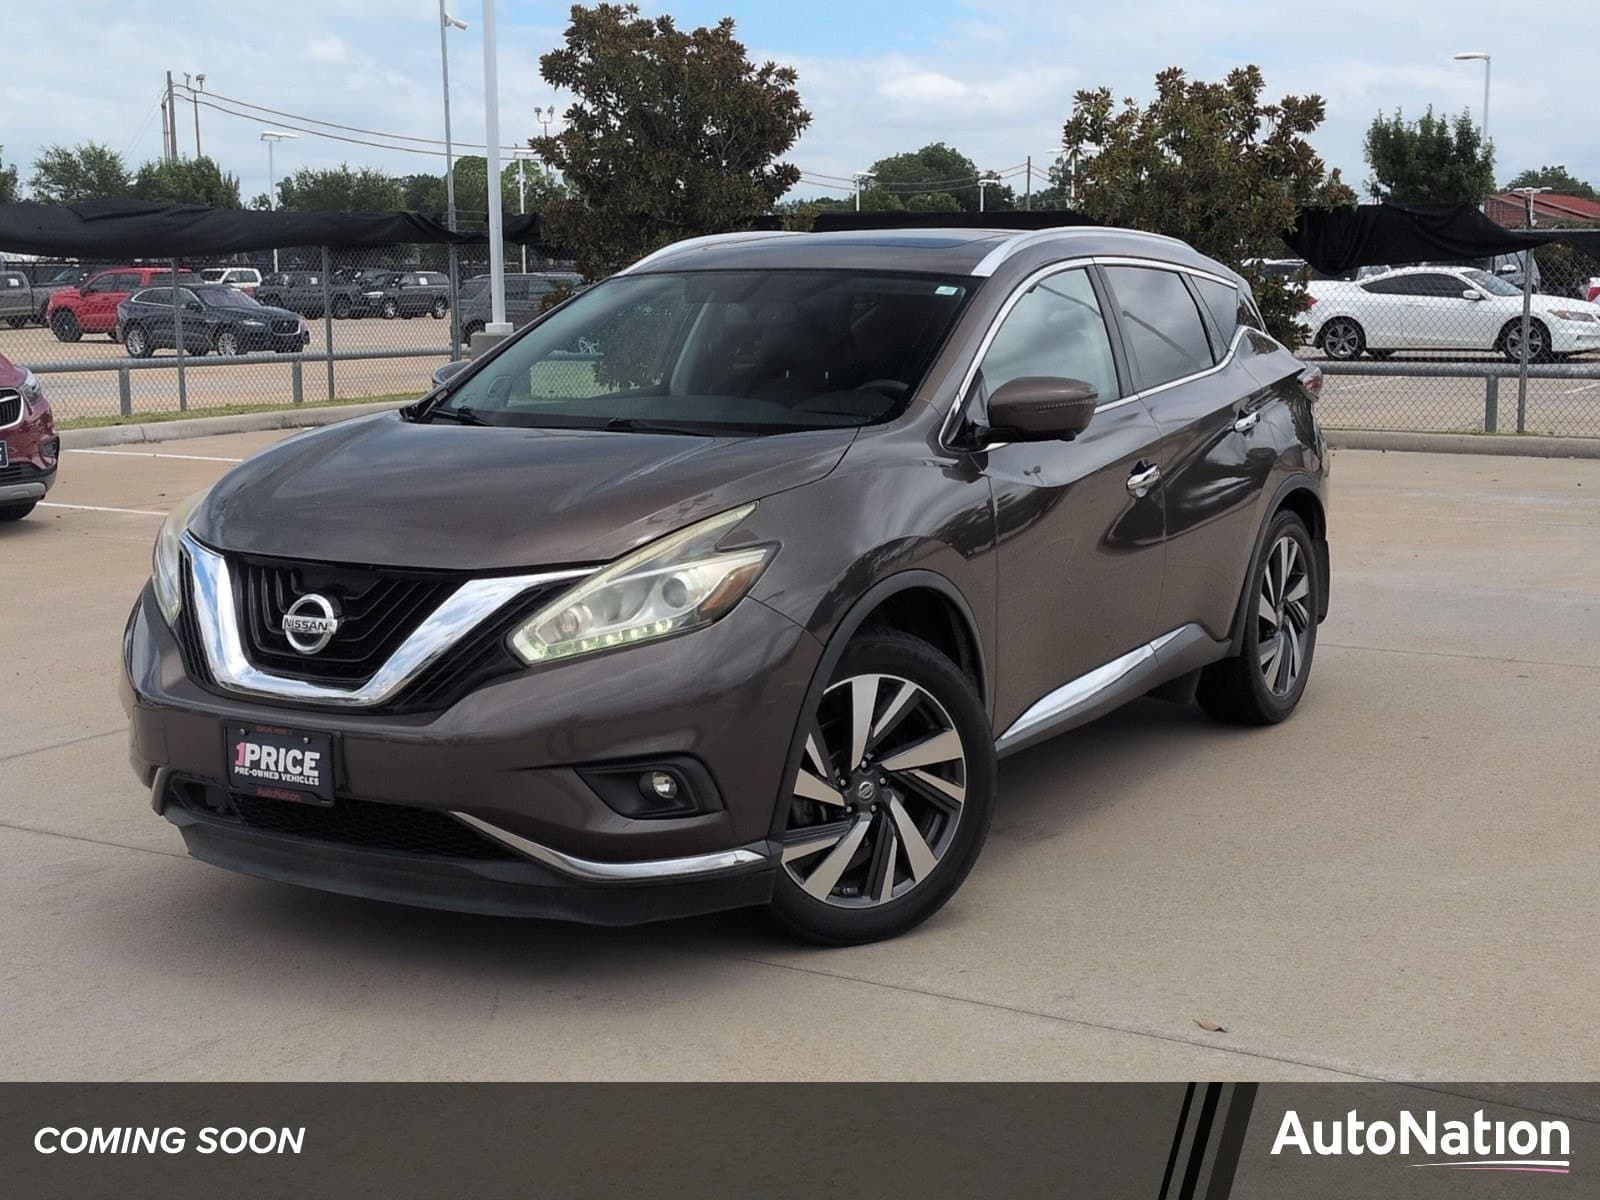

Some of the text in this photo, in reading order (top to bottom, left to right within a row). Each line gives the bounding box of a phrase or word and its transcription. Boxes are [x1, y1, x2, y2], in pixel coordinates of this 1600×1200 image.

[284, 615, 328, 632] NISSAN
[235, 741, 320, 777] 1PRICE
[234, 766, 320, 786] PRE-OWNED VEHICLES
